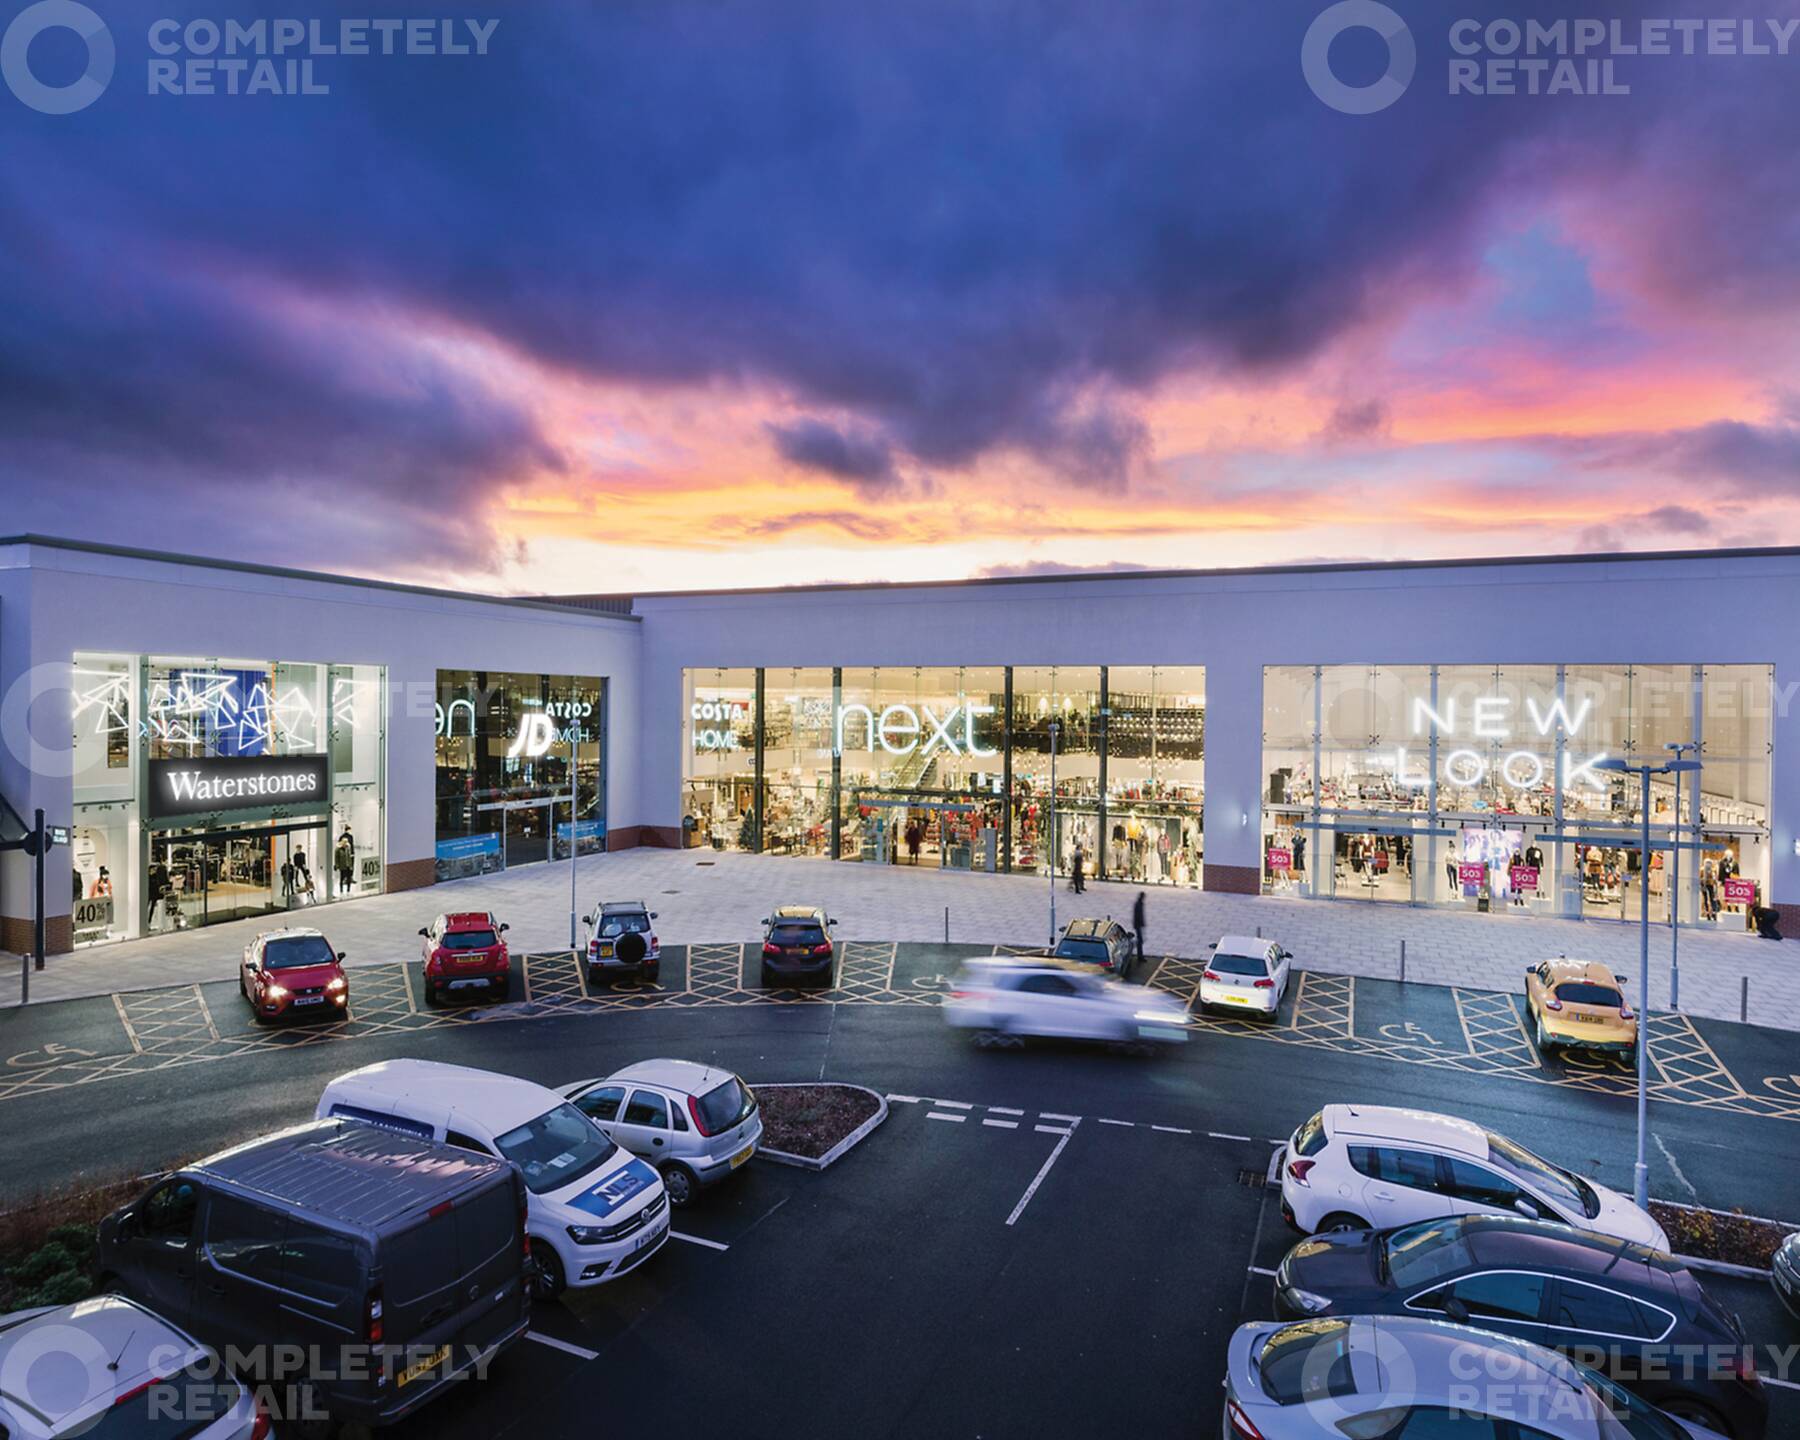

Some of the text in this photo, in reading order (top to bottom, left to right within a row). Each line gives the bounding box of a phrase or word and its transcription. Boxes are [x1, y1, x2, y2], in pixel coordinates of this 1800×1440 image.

[691, 703, 744, 721] COSTA
[837, 702, 997, 757] next
[1413, 697, 1592, 736] NEW
[508, 713, 553, 758] JD
[692, 730, 739, 749] HOME
[167, 770, 316, 801] Waterstones
[1397, 748, 1608, 790] LOOK
